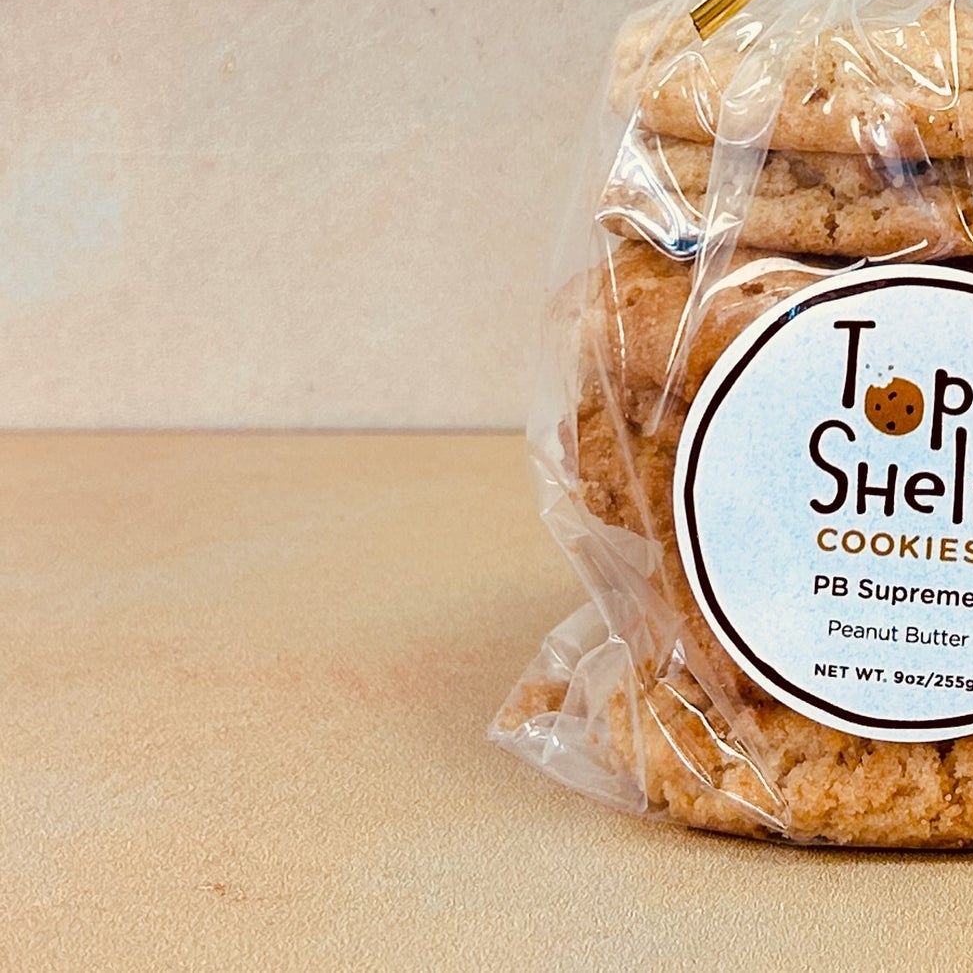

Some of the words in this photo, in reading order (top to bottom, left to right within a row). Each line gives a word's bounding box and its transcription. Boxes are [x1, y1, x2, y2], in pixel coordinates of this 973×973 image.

[813, 575, 849, 597] PB
[828, 619, 899, 643] Peanut
[905, 626, 970, 648] Butter
[814, 663, 850, 679] NET
[855, 667, 888, 683] WT.
